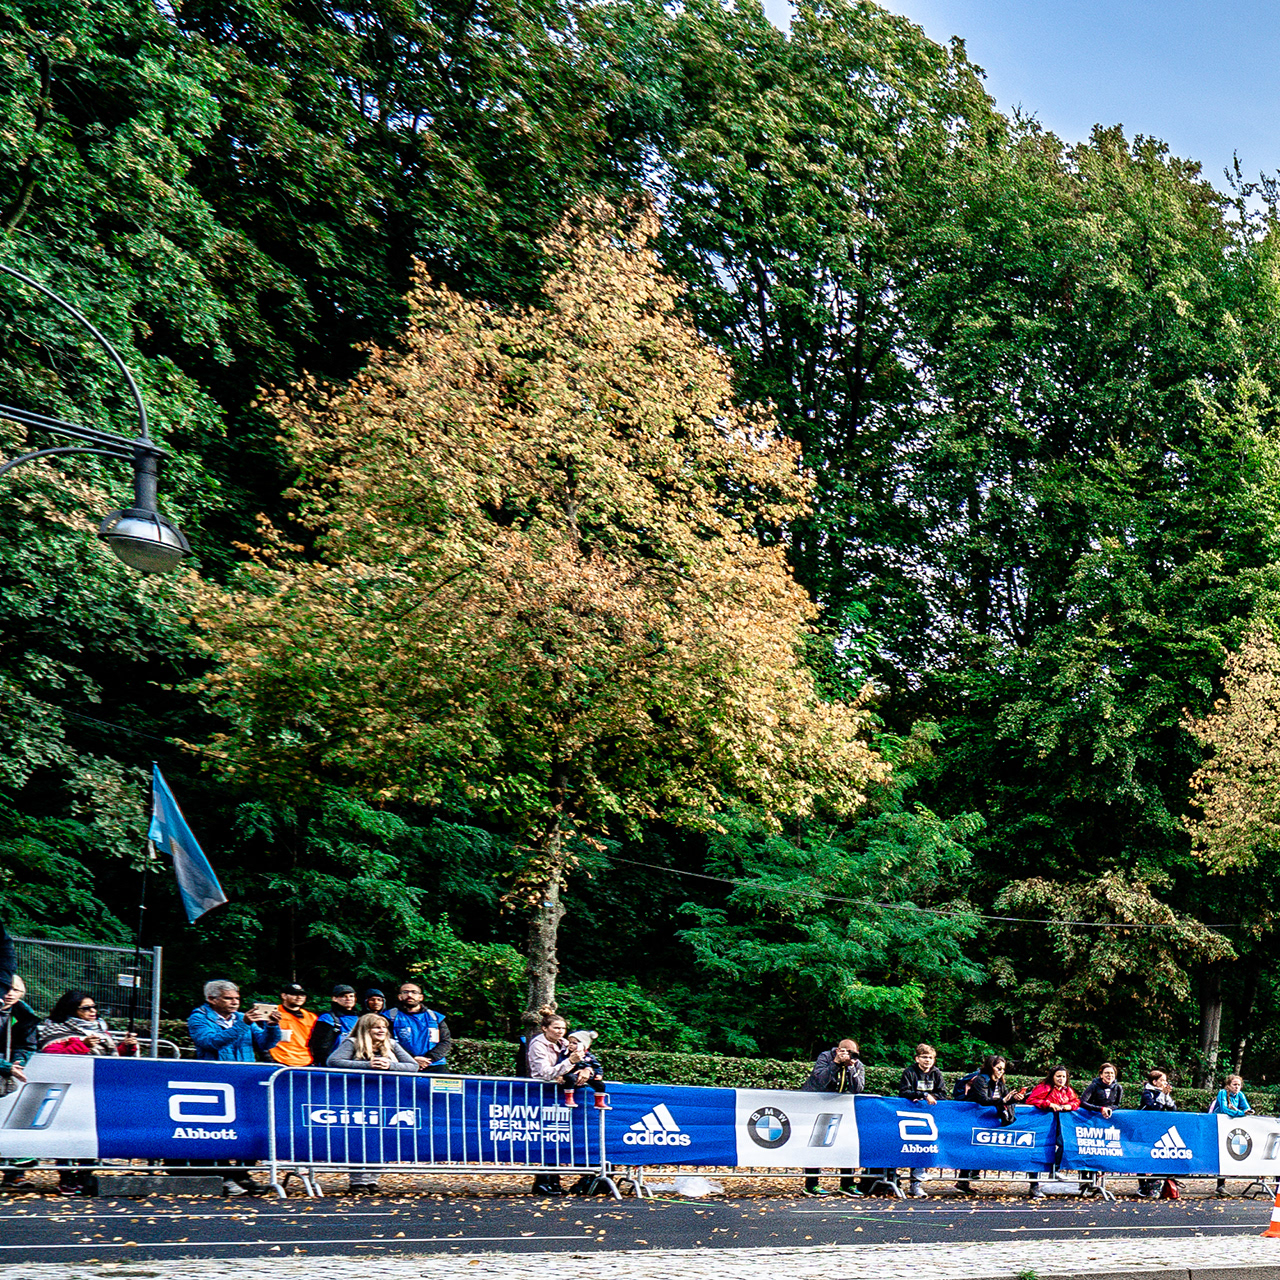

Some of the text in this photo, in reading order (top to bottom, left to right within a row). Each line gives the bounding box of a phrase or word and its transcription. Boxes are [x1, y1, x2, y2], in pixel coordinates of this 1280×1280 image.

[310, 1109, 379, 1126] Giti
[488, 1104, 540, 1119] BMW
[489, 1119, 540, 1131] BERLIN
[172, 1127, 238, 1140] Abbott
[489, 1130, 570, 1143] MARATHON
[622, 1130, 691, 1146] adidas
[976, 1131, 1012, 1145] Giti
[1075, 1126, 1103, 1139] BMW
[901, 1143, 939, 1154] Abbott
[1077, 1138, 1105, 1148] BERLIN
[1078, 1146, 1123, 1157] MARATHON
[1150, 1147, 1193, 1160] adidas
